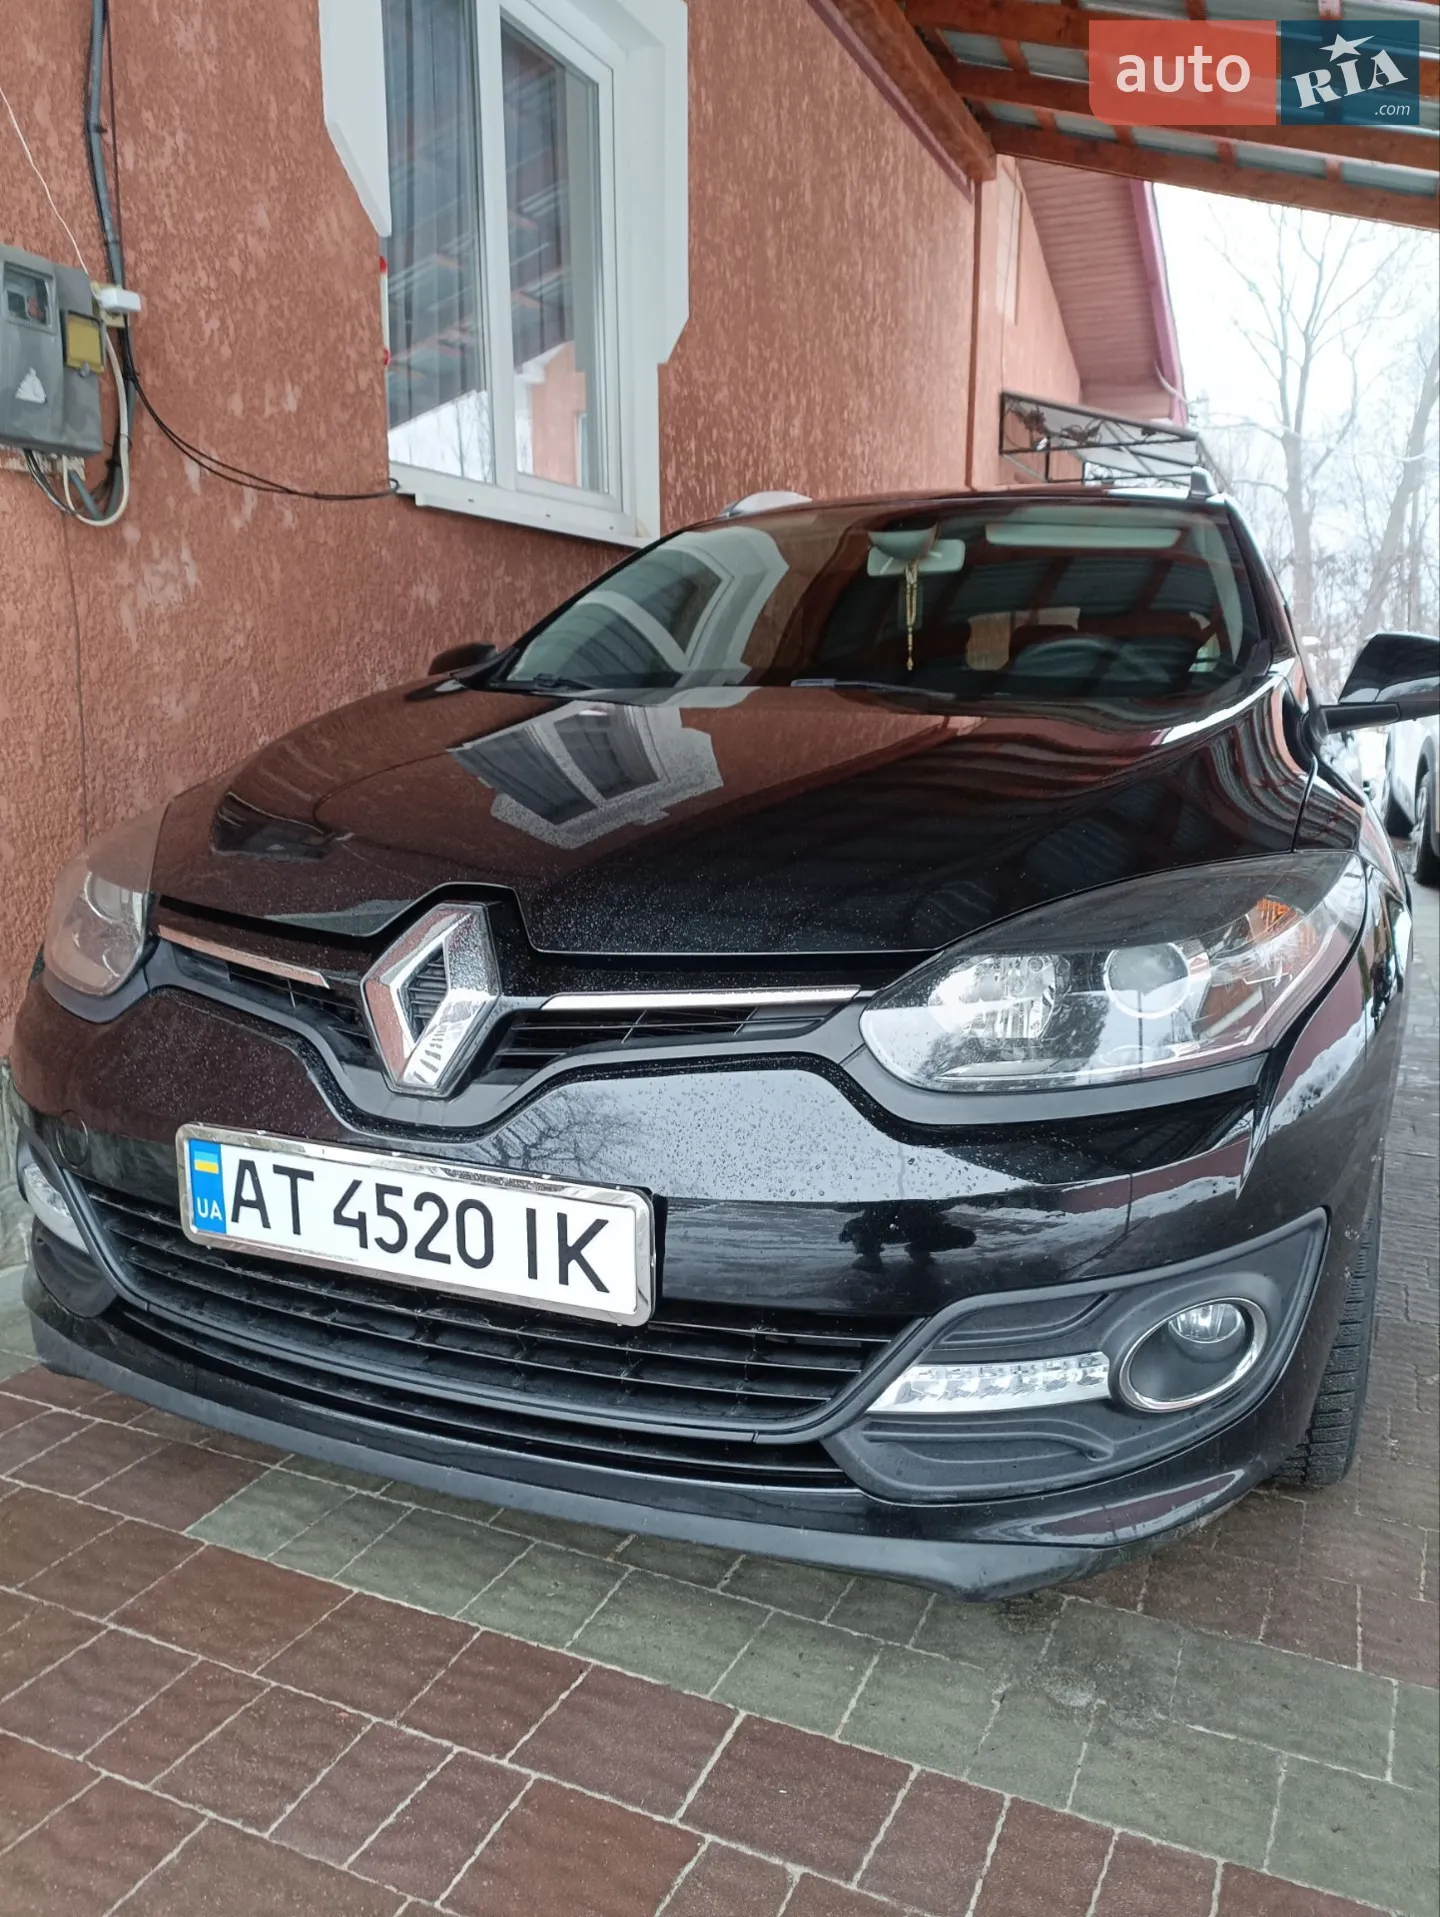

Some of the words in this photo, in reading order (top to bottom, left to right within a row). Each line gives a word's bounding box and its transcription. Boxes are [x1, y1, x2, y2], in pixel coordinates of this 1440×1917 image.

[197, 1197, 223, 1221] UA
[231, 1159, 314, 1236] AT
[333, 1179, 494, 1269] 4520
[526, 1207, 609, 1293] IK
